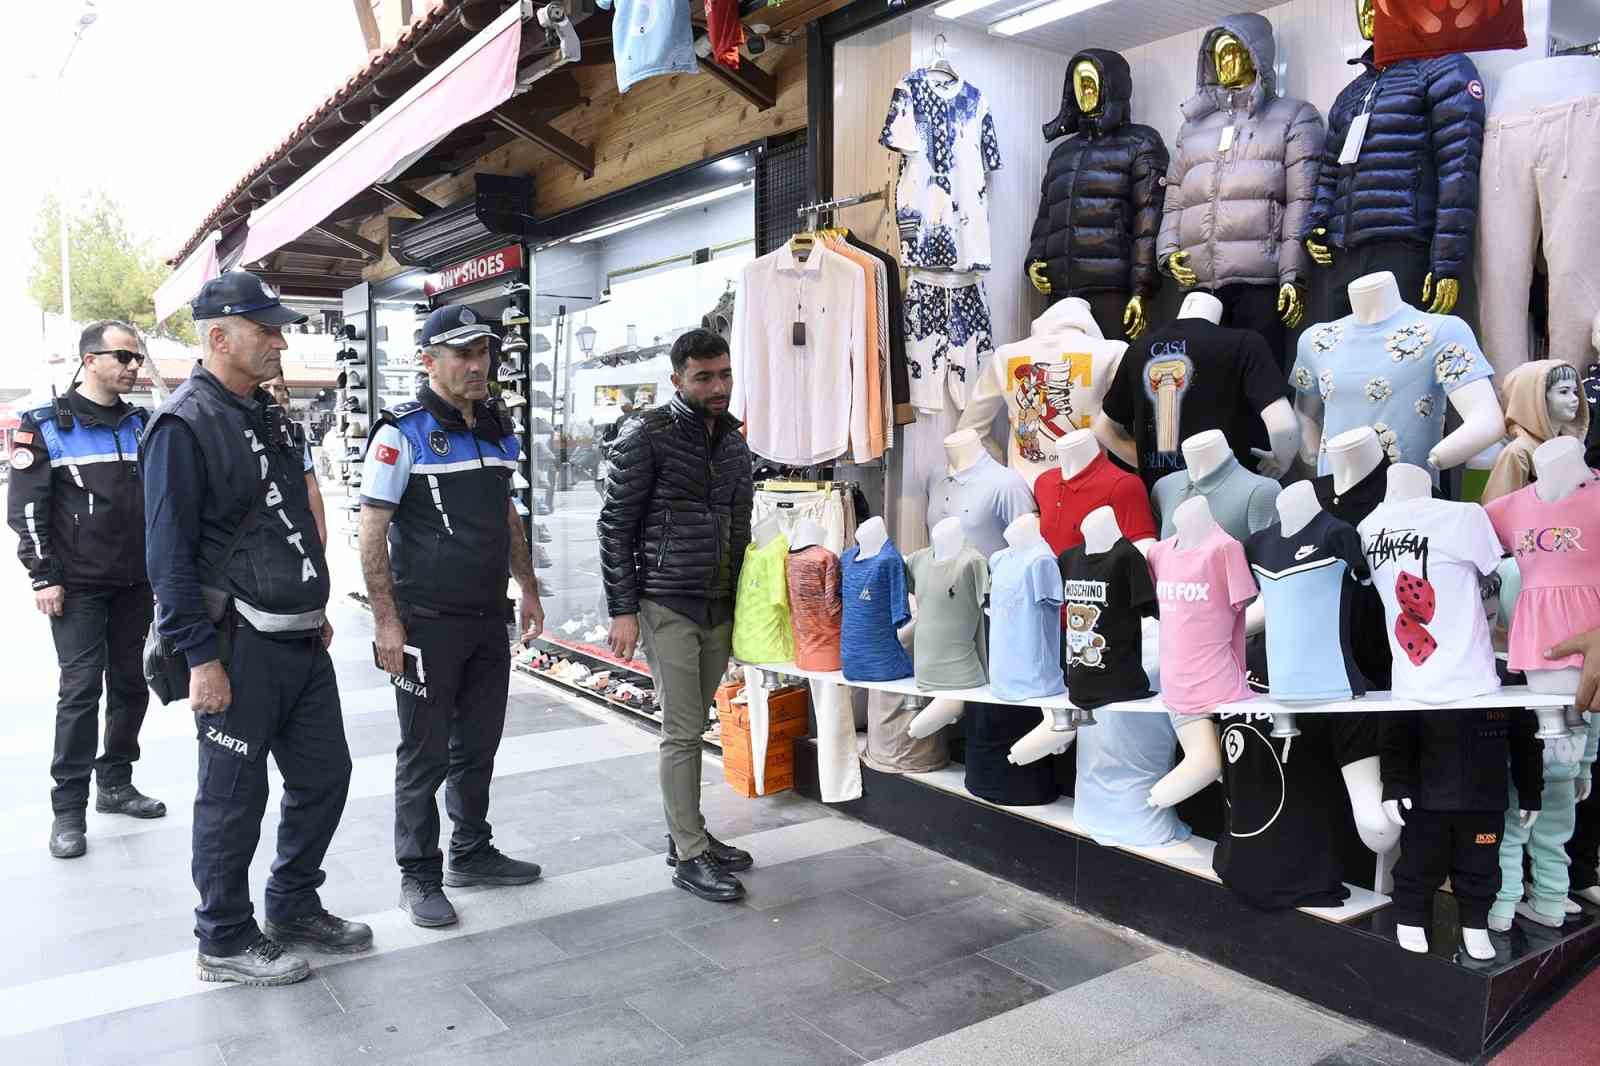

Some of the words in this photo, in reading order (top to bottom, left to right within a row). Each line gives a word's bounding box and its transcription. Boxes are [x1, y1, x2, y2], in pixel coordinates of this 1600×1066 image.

[432, 266, 462, 292] ONY
[463, 252, 505, 282] SHOES
[1150, 339, 1187, 357] CASA
[1066, 583, 1103, 599] MOSCHINO
[1176, 582, 1210, 601] FOX
[394, 676, 428, 699] ZABITA
[206, 726, 249, 756] ZABITA
